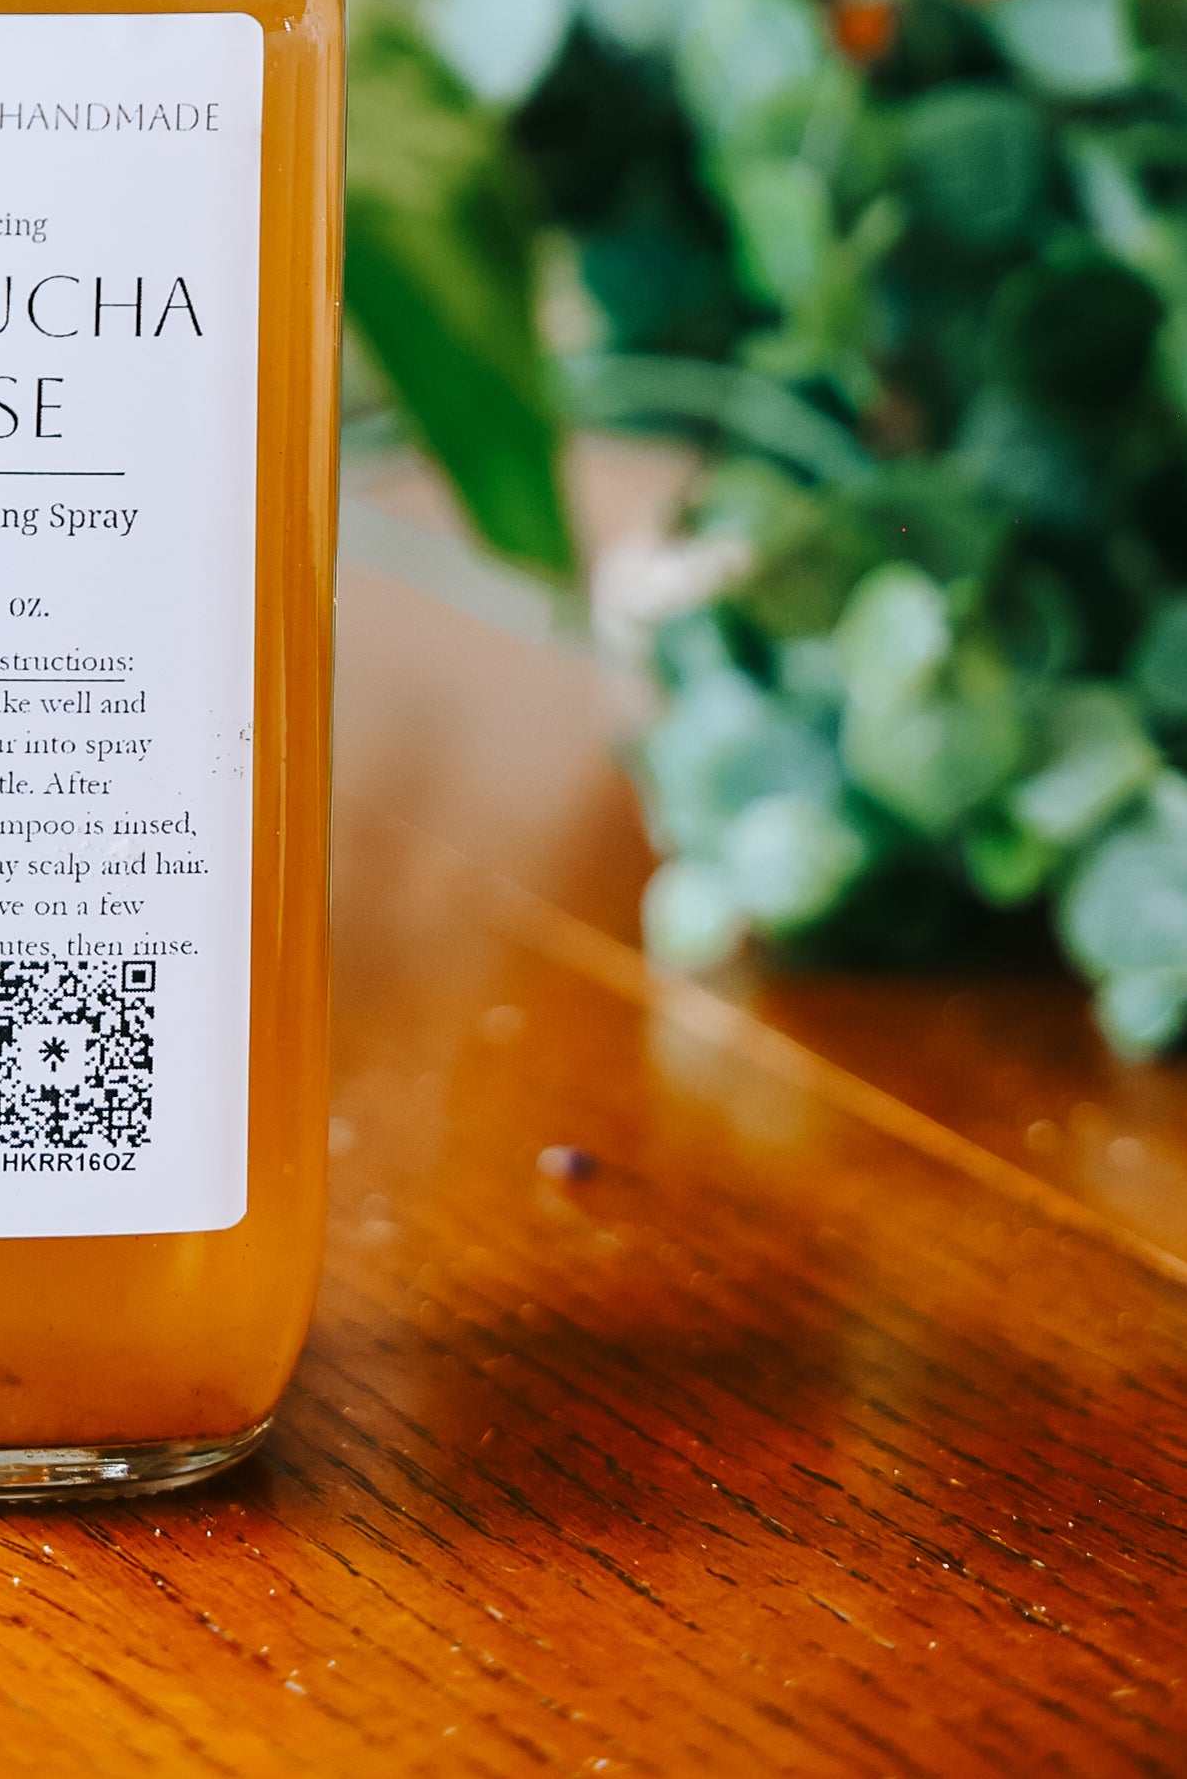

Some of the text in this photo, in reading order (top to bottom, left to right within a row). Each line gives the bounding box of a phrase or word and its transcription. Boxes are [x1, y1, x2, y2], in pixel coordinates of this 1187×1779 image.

[0, 102, 220, 132] HANDMADE
[49, 502, 140, 538] Spray
[8, 596, 50, 618] oz.
[38, 690, 92, 715] well
[99, 689, 147, 715] and
[22, 729, 77, 756] into
[85, 738, 154, 763] spray
[41, 770, 113, 796] After
[82, 810, 105, 836] is
[111, 811, 197, 841] rinsed,
[27, 851, 91, 884] scalp
[100, 852, 147, 877] and
[154, 850, 209, 876] hair.
[33, 900, 69, 917] on
[76, 900, 89, 917] a
[98, 891, 146, 917] few
[66, 933, 124, 957] then
[131, 932, 199, 957] rinse.
